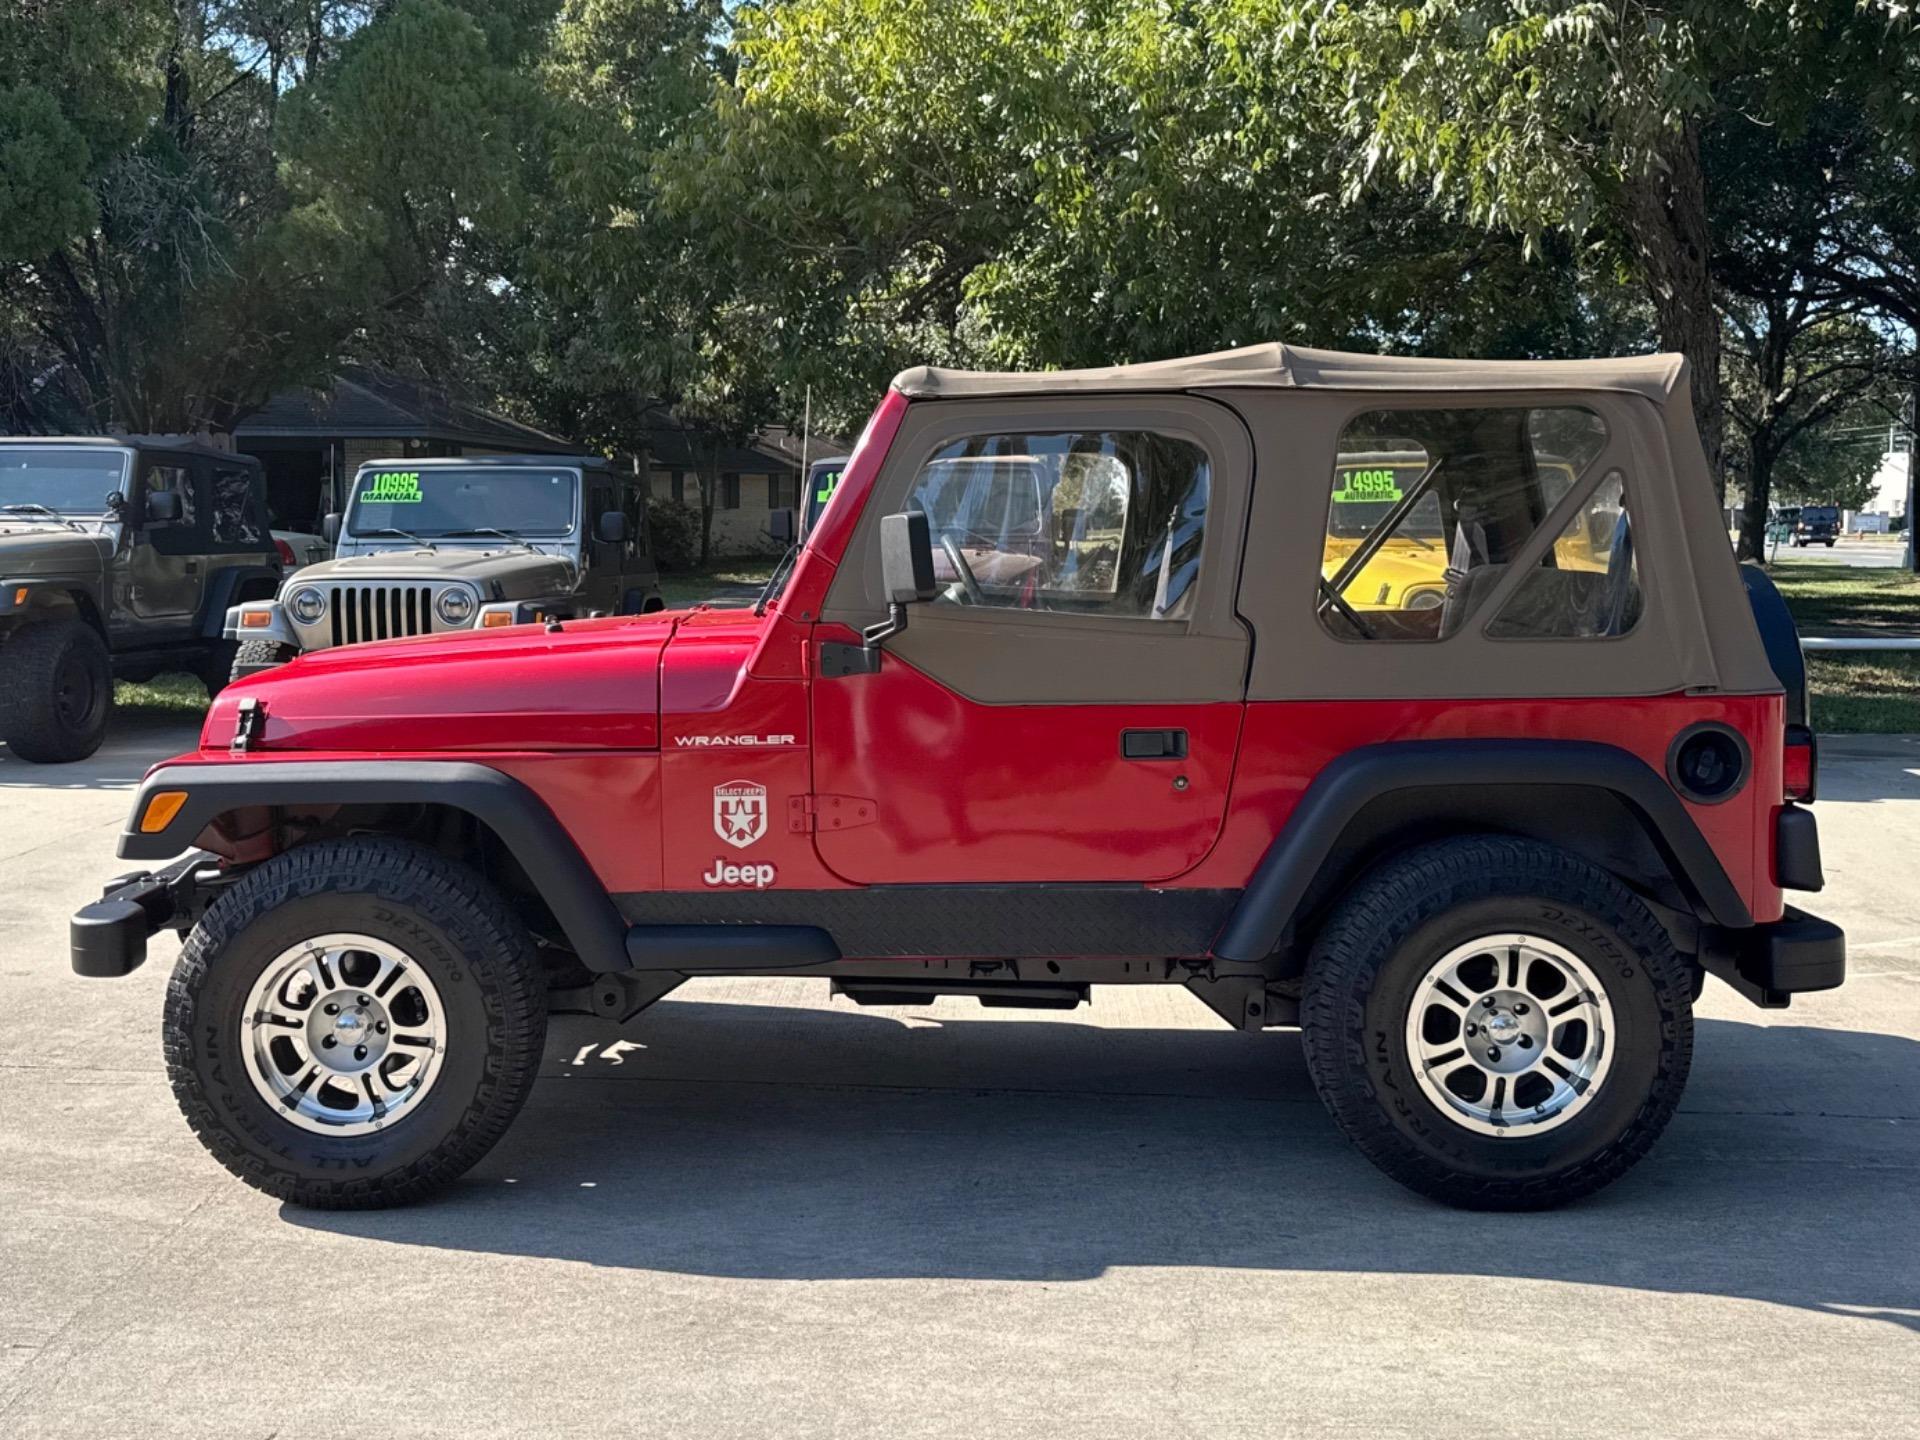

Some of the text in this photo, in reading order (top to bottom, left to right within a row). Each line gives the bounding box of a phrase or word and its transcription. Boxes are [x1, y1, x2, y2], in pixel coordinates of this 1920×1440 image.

[373, 472, 419, 492] 10995
[1343, 470, 1394, 492] 14995
[362, 492, 421, 501] MANUAL
[1344, 490, 1394, 500] AUTOMATIC
[674, 735, 795, 746] WRANGLER
[704, 859, 775, 889] Jeep
[311, 1152, 380, 1170] ALL
